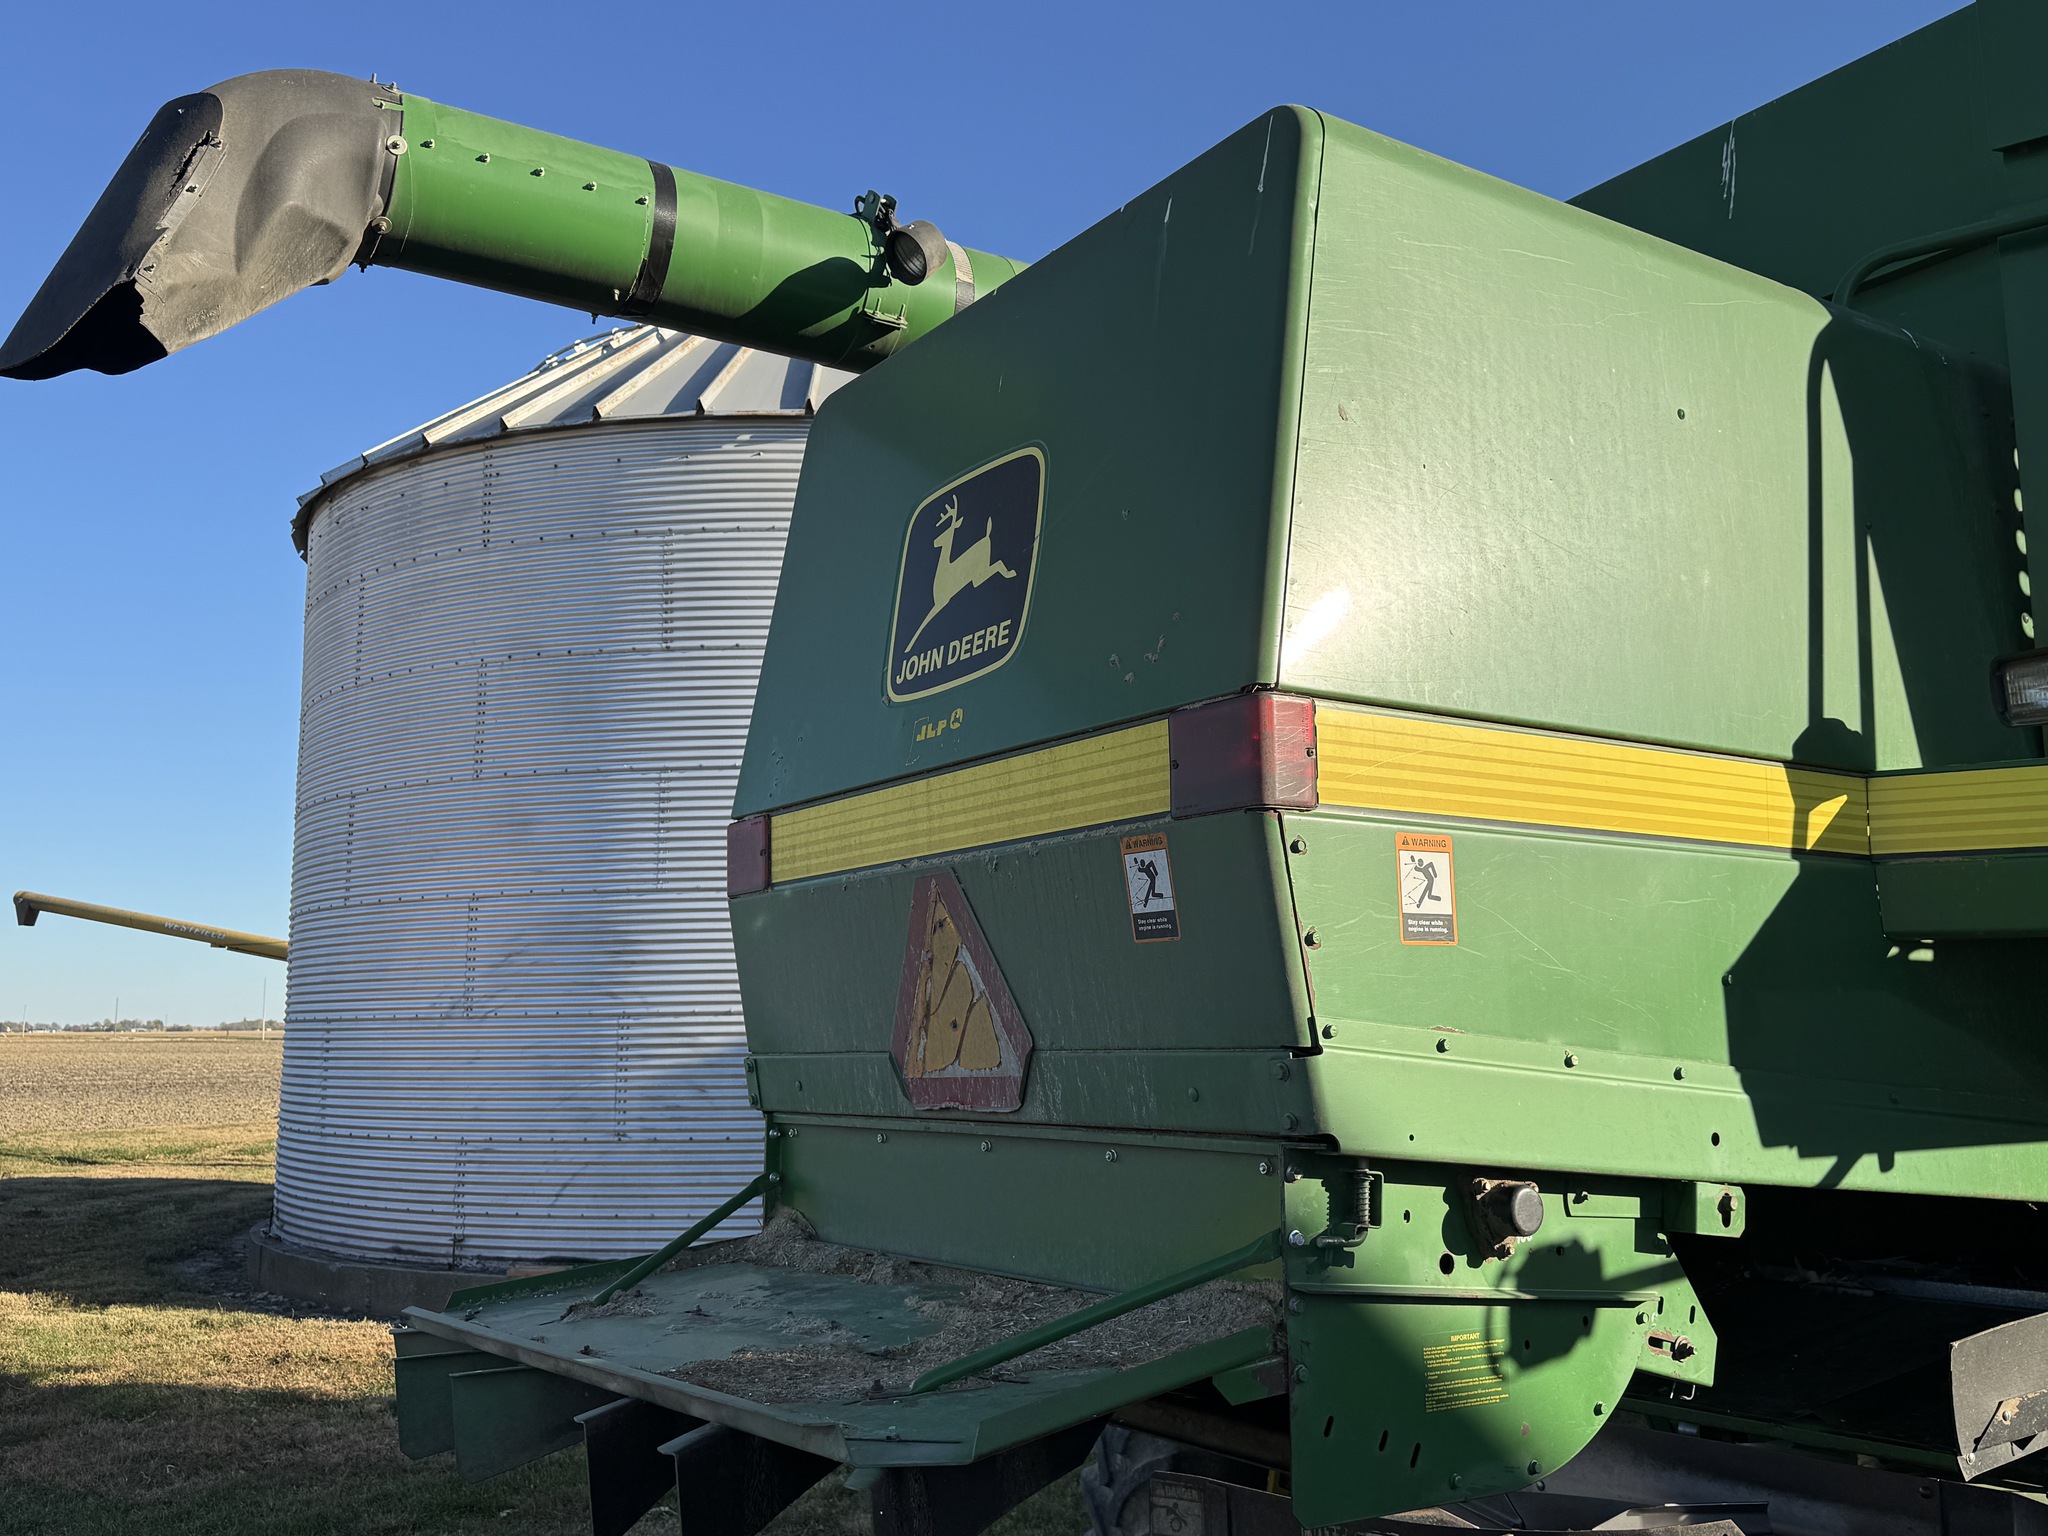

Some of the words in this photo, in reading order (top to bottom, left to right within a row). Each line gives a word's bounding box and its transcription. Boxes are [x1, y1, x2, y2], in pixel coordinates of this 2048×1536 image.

[896, 645, 945, 684] JOHN
[947, 619, 1011, 666] DEERE
[916, 719, 947, 742] JLP
[1133, 836, 1163, 849] WARNING
[1411, 838, 1447, 848] WARNING
[164, 921, 227, 940] WESTFIELD
[1450, 1332, 1481, 1342] IMPORTANT
